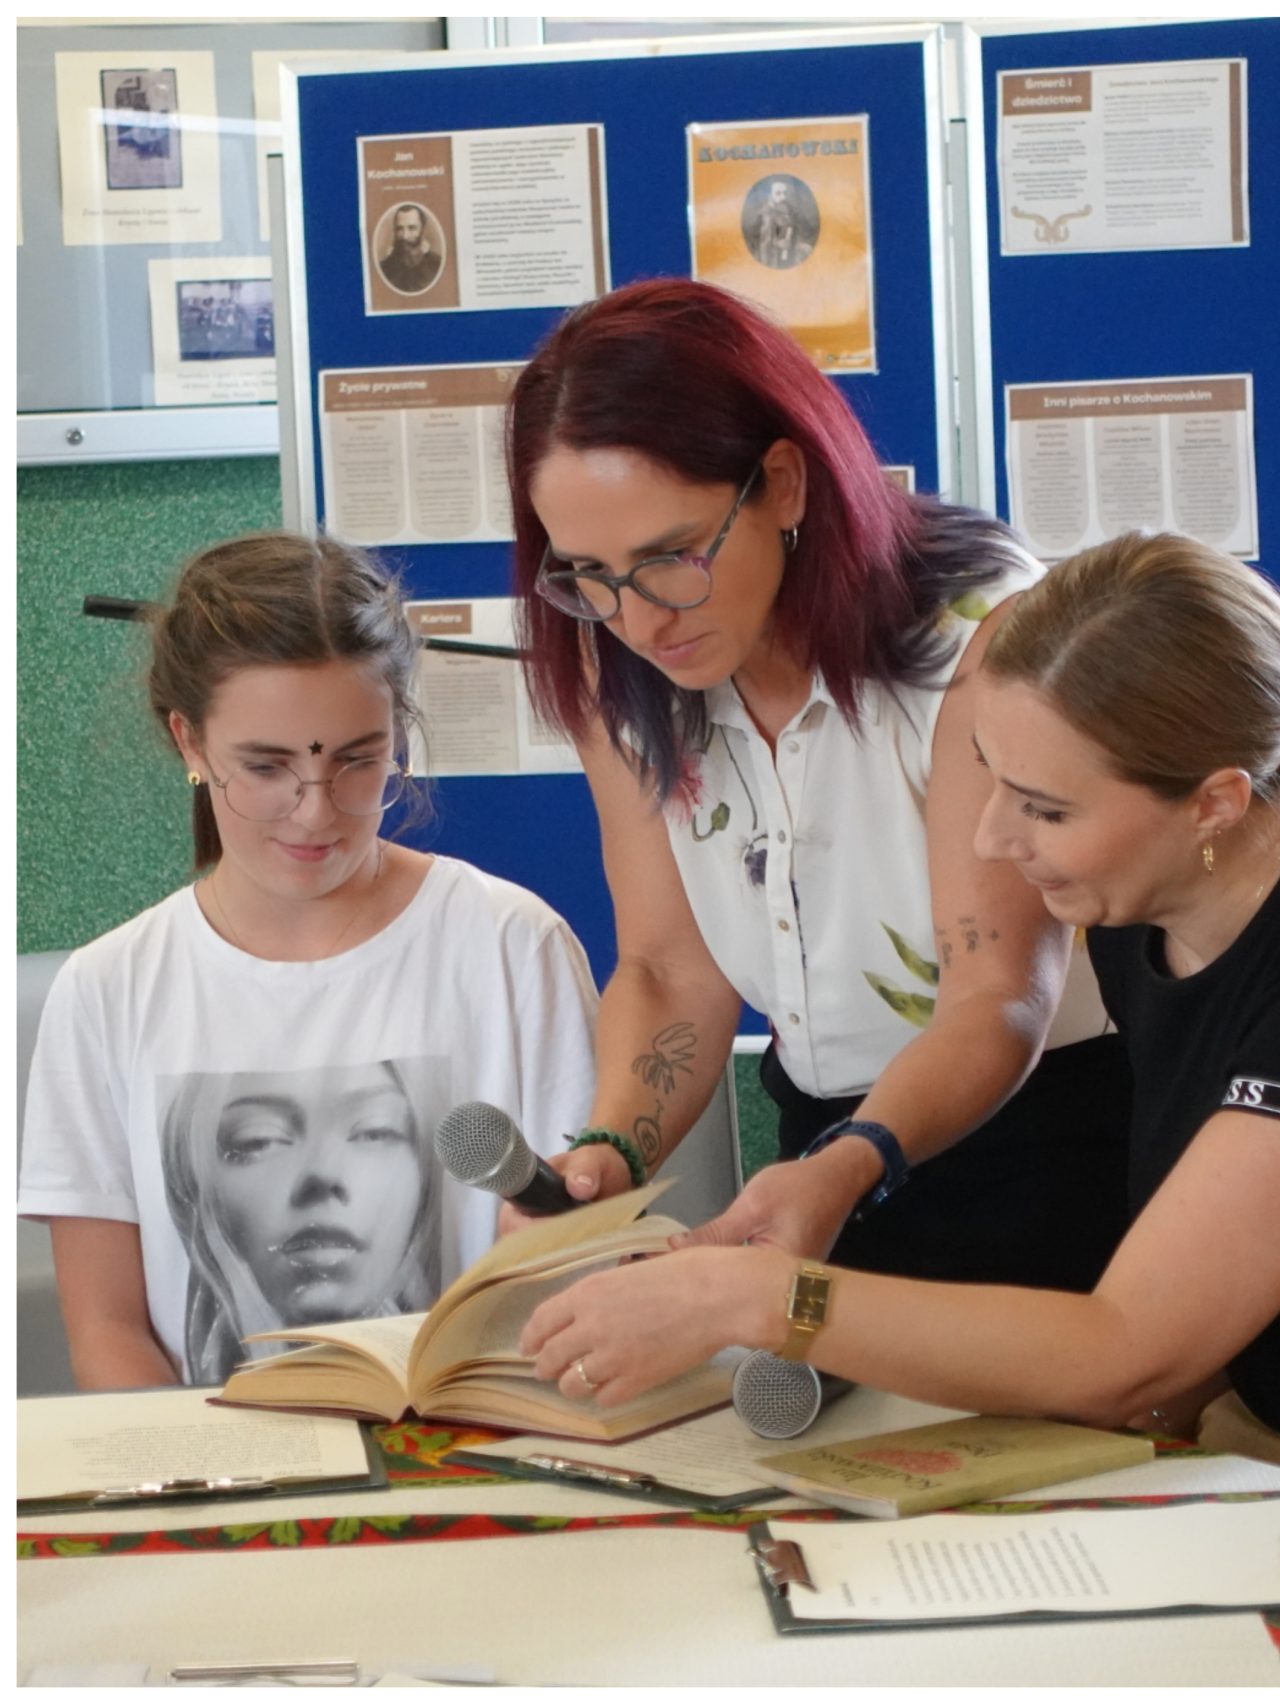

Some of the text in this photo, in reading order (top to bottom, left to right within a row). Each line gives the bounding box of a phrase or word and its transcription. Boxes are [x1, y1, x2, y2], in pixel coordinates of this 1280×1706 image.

[1012, 94, 1083, 109] dziedzictwo
[393, 152, 415, 162] Jan
[698, 138, 859, 163] KOCHANOWSKI
[367, 166, 445, 180] Kochanowski
[372, 380, 428, 393] prywatne
[1069, 394, 1111, 408] pisarze
[1113, 397, 1121, 405] o
[1123, 390, 1213, 405] Kochanowskim
[420, 613, 463, 624] Kariera
